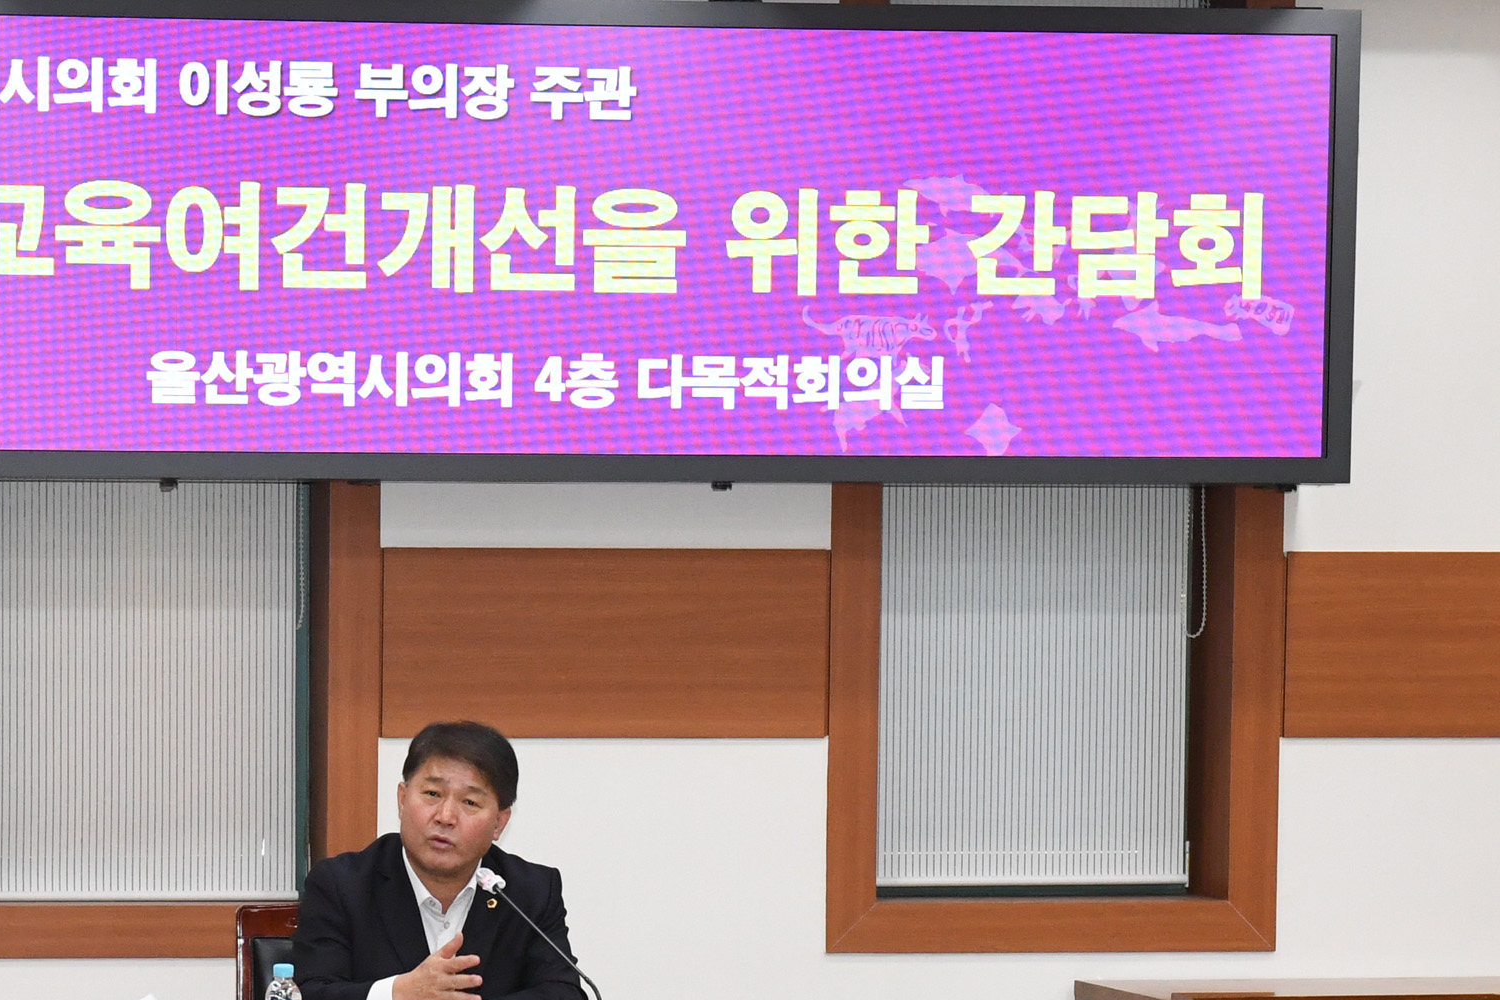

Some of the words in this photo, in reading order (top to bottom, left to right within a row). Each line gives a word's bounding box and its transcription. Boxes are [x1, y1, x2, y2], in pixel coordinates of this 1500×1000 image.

[179, 60, 338, 118] 이성룡
[355, 64, 514, 119] 부의장
[530, 67, 637, 121] 주관
[725, 188, 931, 297] 위한
[966, 190, 1266, 300] 간담회
[146, 350, 514, 408] 울산광역시의회
[534, 353, 619, 409] 4층
[636, 354, 945, 411] 다목적회의실
